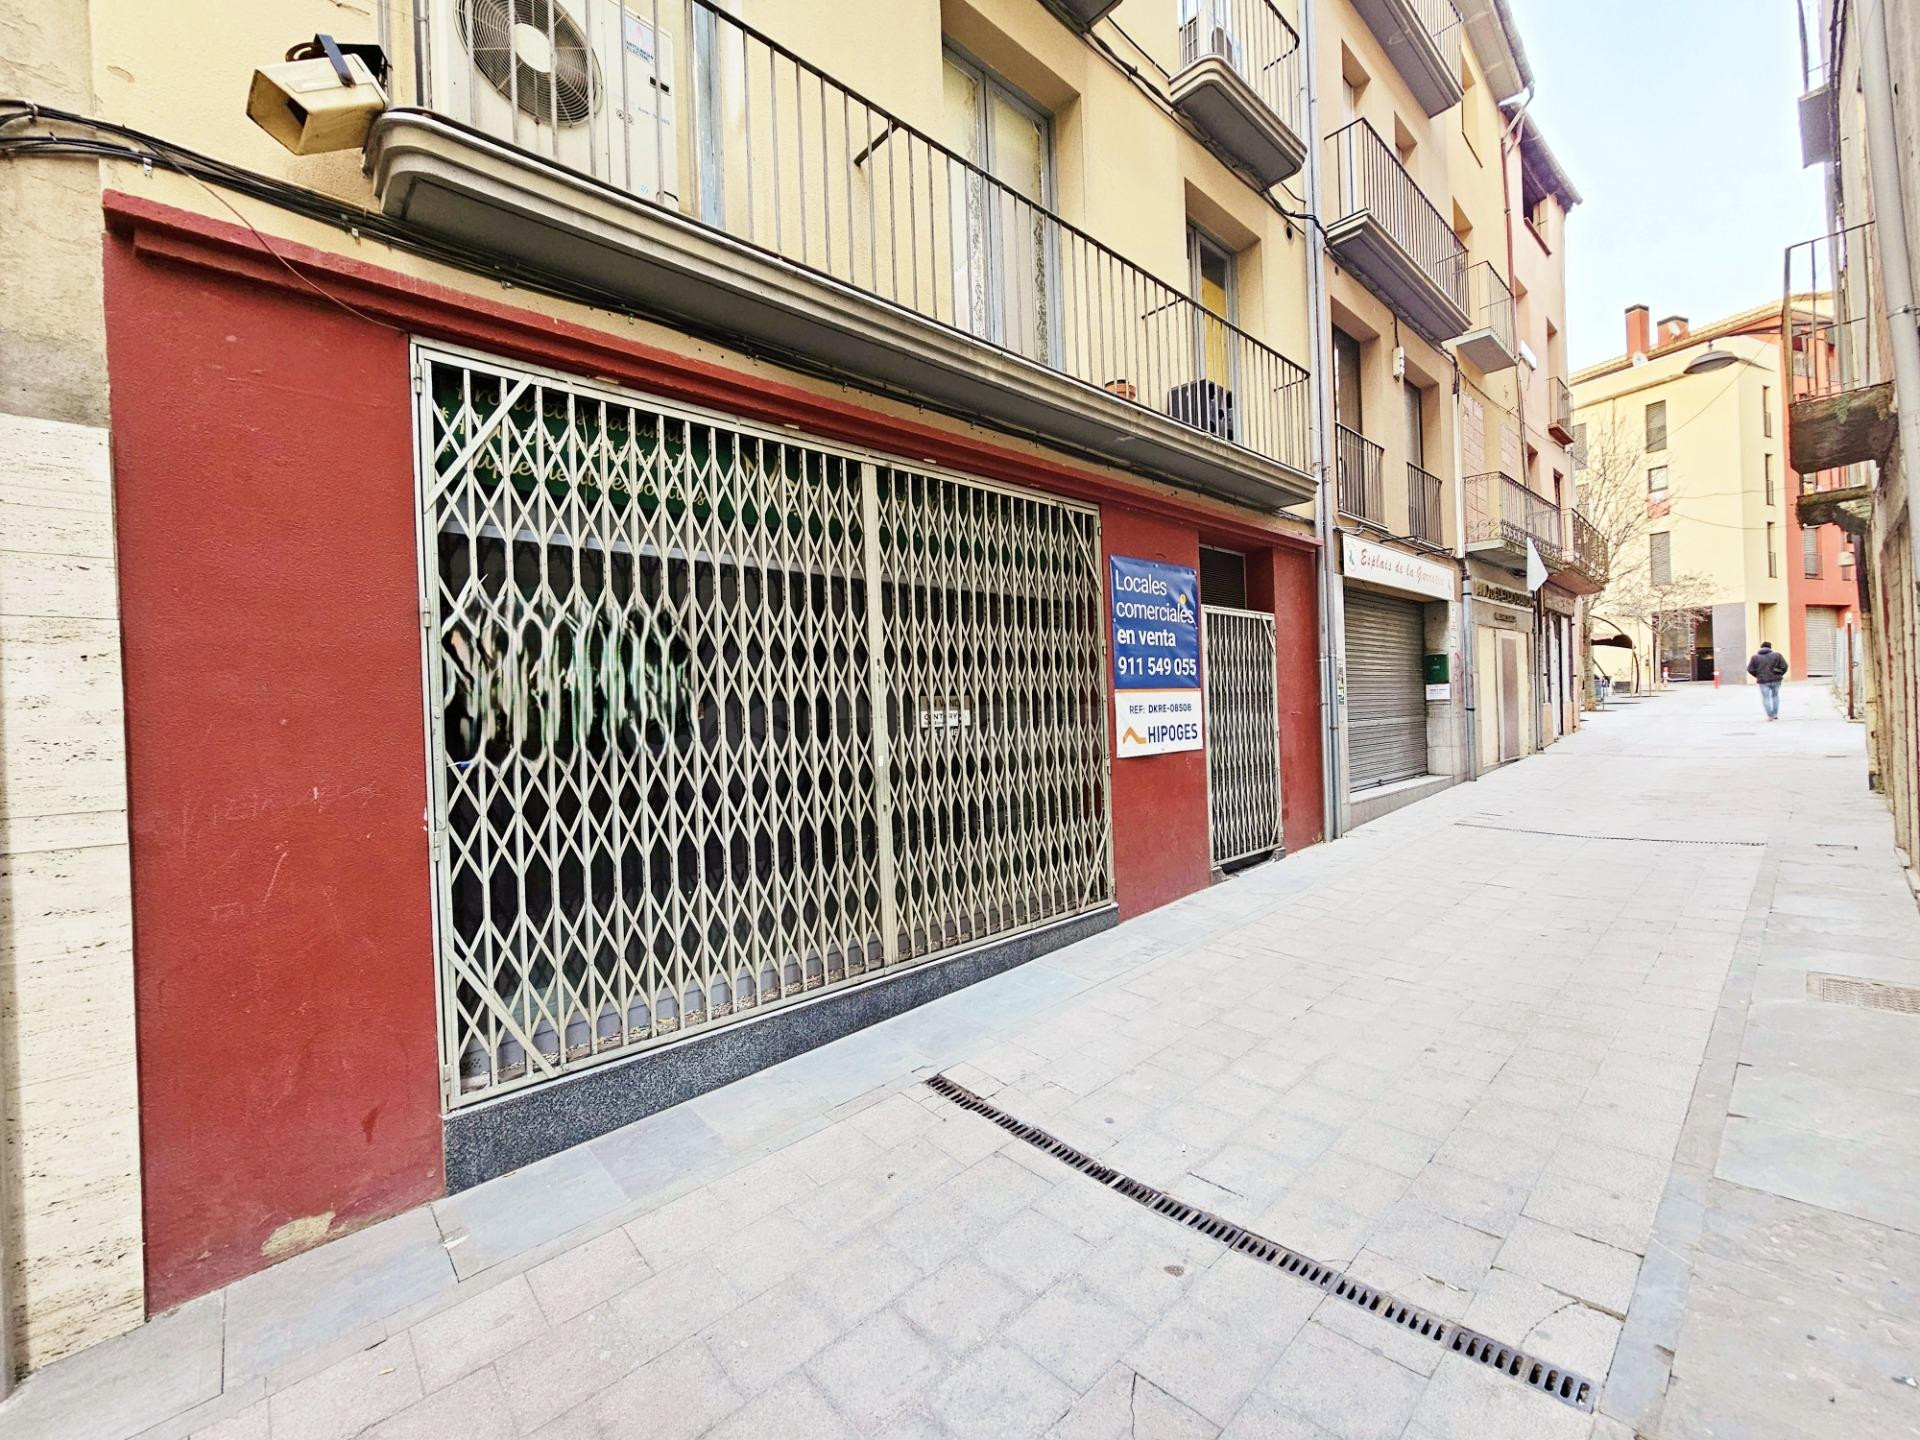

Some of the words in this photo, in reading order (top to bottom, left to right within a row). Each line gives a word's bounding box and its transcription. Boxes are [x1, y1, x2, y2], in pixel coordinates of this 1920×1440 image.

[1115, 569, 1167, 596] Locales
[1116, 601, 1194, 624] comerciales
[1117, 628, 1135, 645] en
[1138, 629, 1177, 647] venta
[1118, 656, 1143, 675] 911
[1147, 657, 1171, 676] 549
[1174, 658, 1197, 676] 055
[1129, 705, 1145, 715] REF:
[1148, 703, 1192, 714] DKRE-08508
[1148, 723, 1199, 744] HIPOGES
